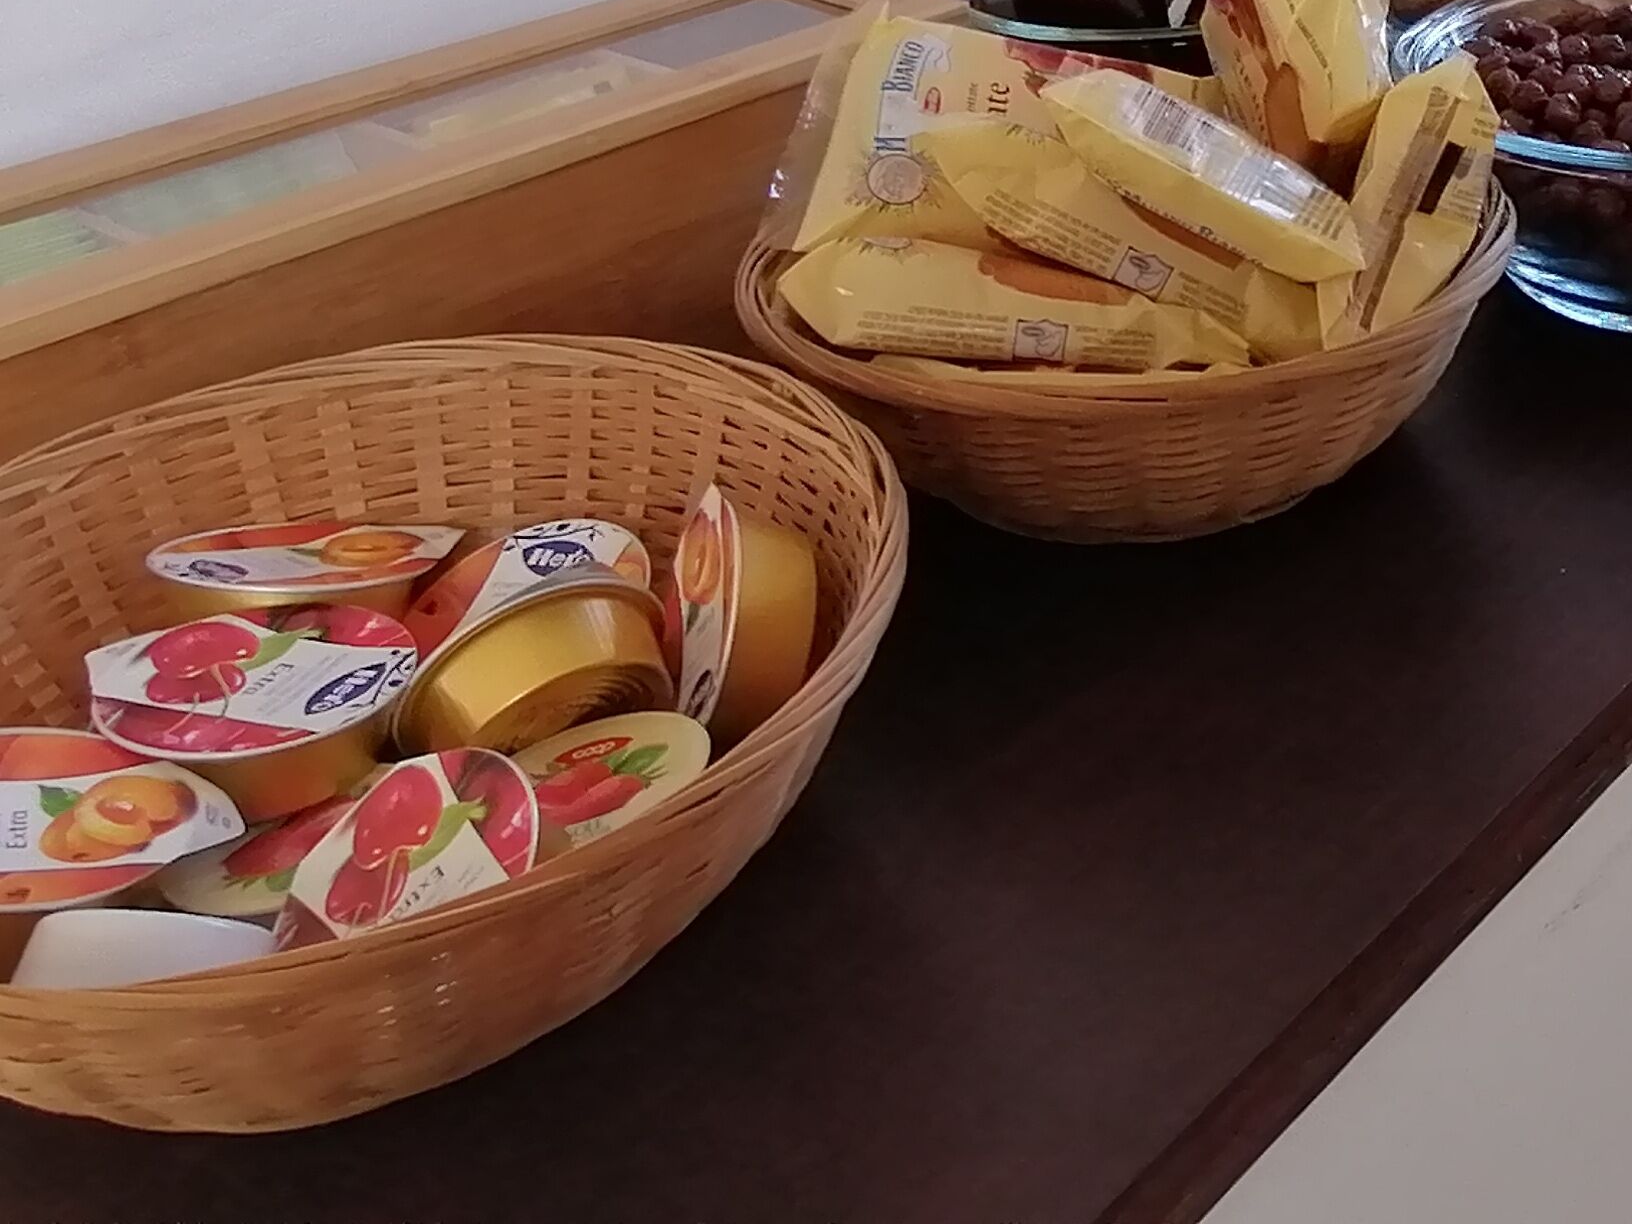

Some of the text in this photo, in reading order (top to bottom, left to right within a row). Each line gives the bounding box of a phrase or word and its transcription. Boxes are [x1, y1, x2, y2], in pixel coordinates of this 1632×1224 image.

[881, 41, 925, 92] BIANCO
[310, 669, 379, 713] Hero
[570, 739, 616, 761] coop
[6, 809, 28, 849] Extra
